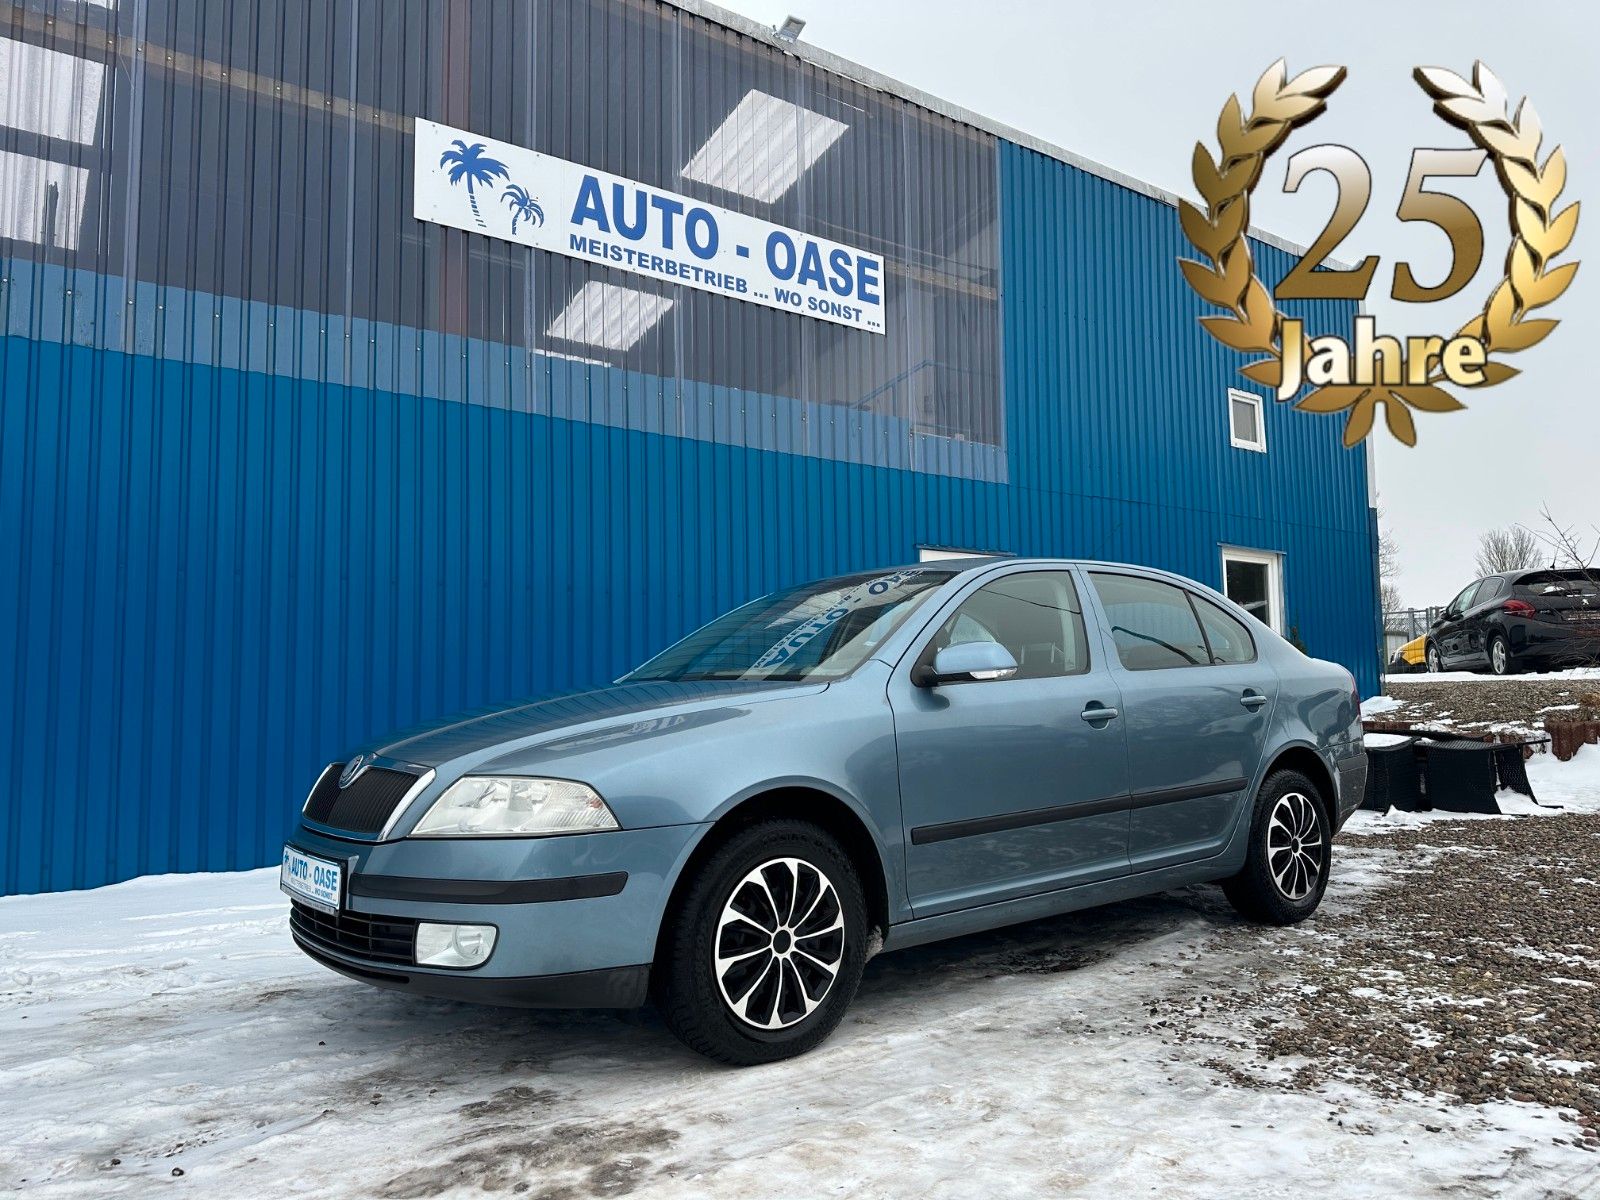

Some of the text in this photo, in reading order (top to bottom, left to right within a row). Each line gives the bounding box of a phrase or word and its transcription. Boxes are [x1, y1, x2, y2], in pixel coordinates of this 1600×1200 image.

[569, 233, 748, 294] MEISTERBETRIEB
[774, 286, 802, 307] WO
[807, 296, 863, 322] SONST
[570, 174, 880, 306] AUTO - OASE
[291, 856, 308, 880] AUTO
[314, 866, 337, 891] OASE
